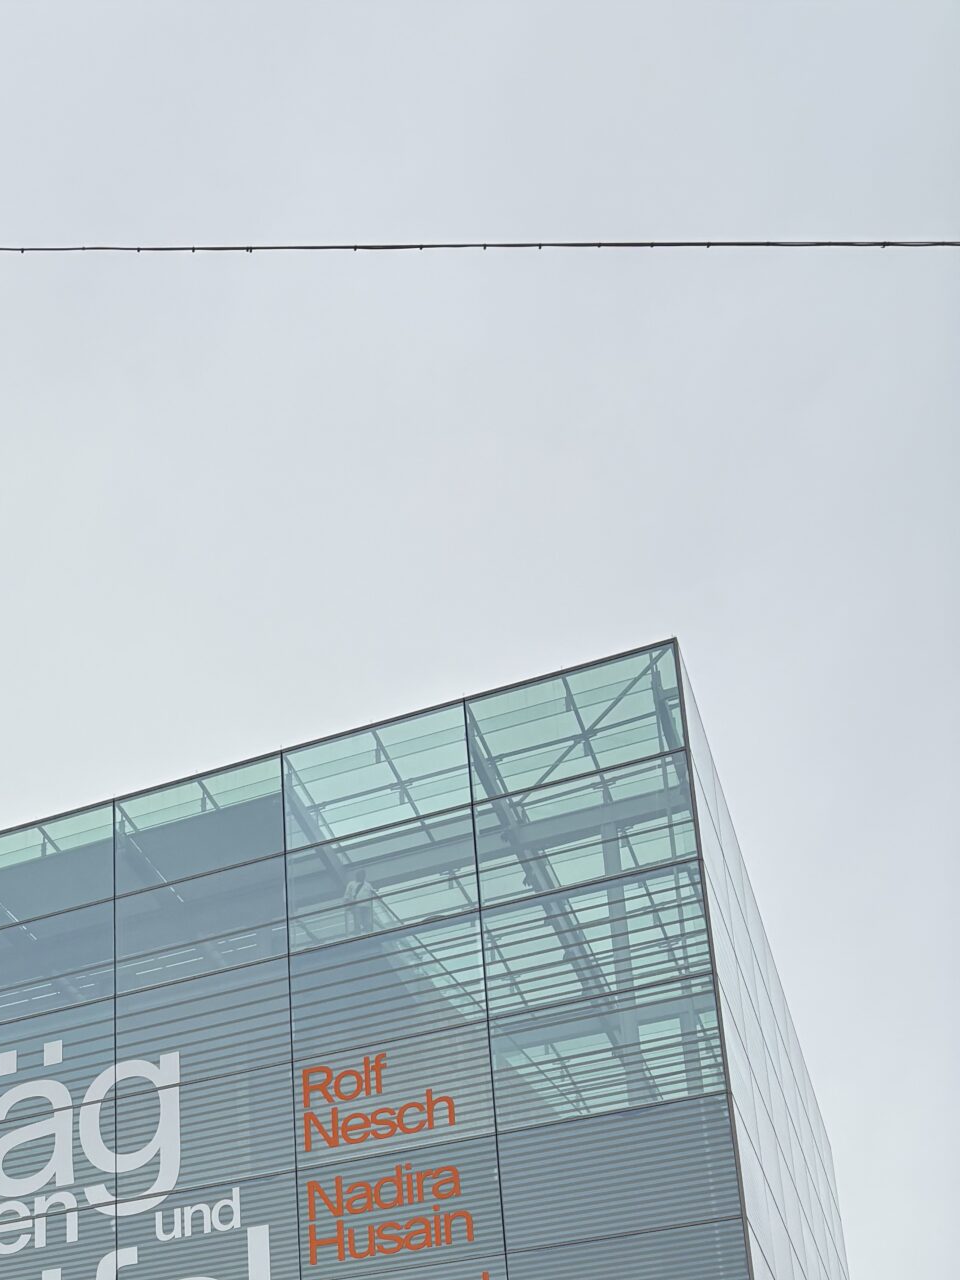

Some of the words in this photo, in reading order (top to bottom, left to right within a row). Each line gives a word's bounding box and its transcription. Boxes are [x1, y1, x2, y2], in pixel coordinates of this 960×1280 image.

[302, 1053, 386, 1107] Rolf
[304, 1089, 456, 1152] Nesch
[155, 1187, 241, 1241] und
[307, 1164, 461, 1220] Nadira
[308, 1205, 474, 1265] Husain
